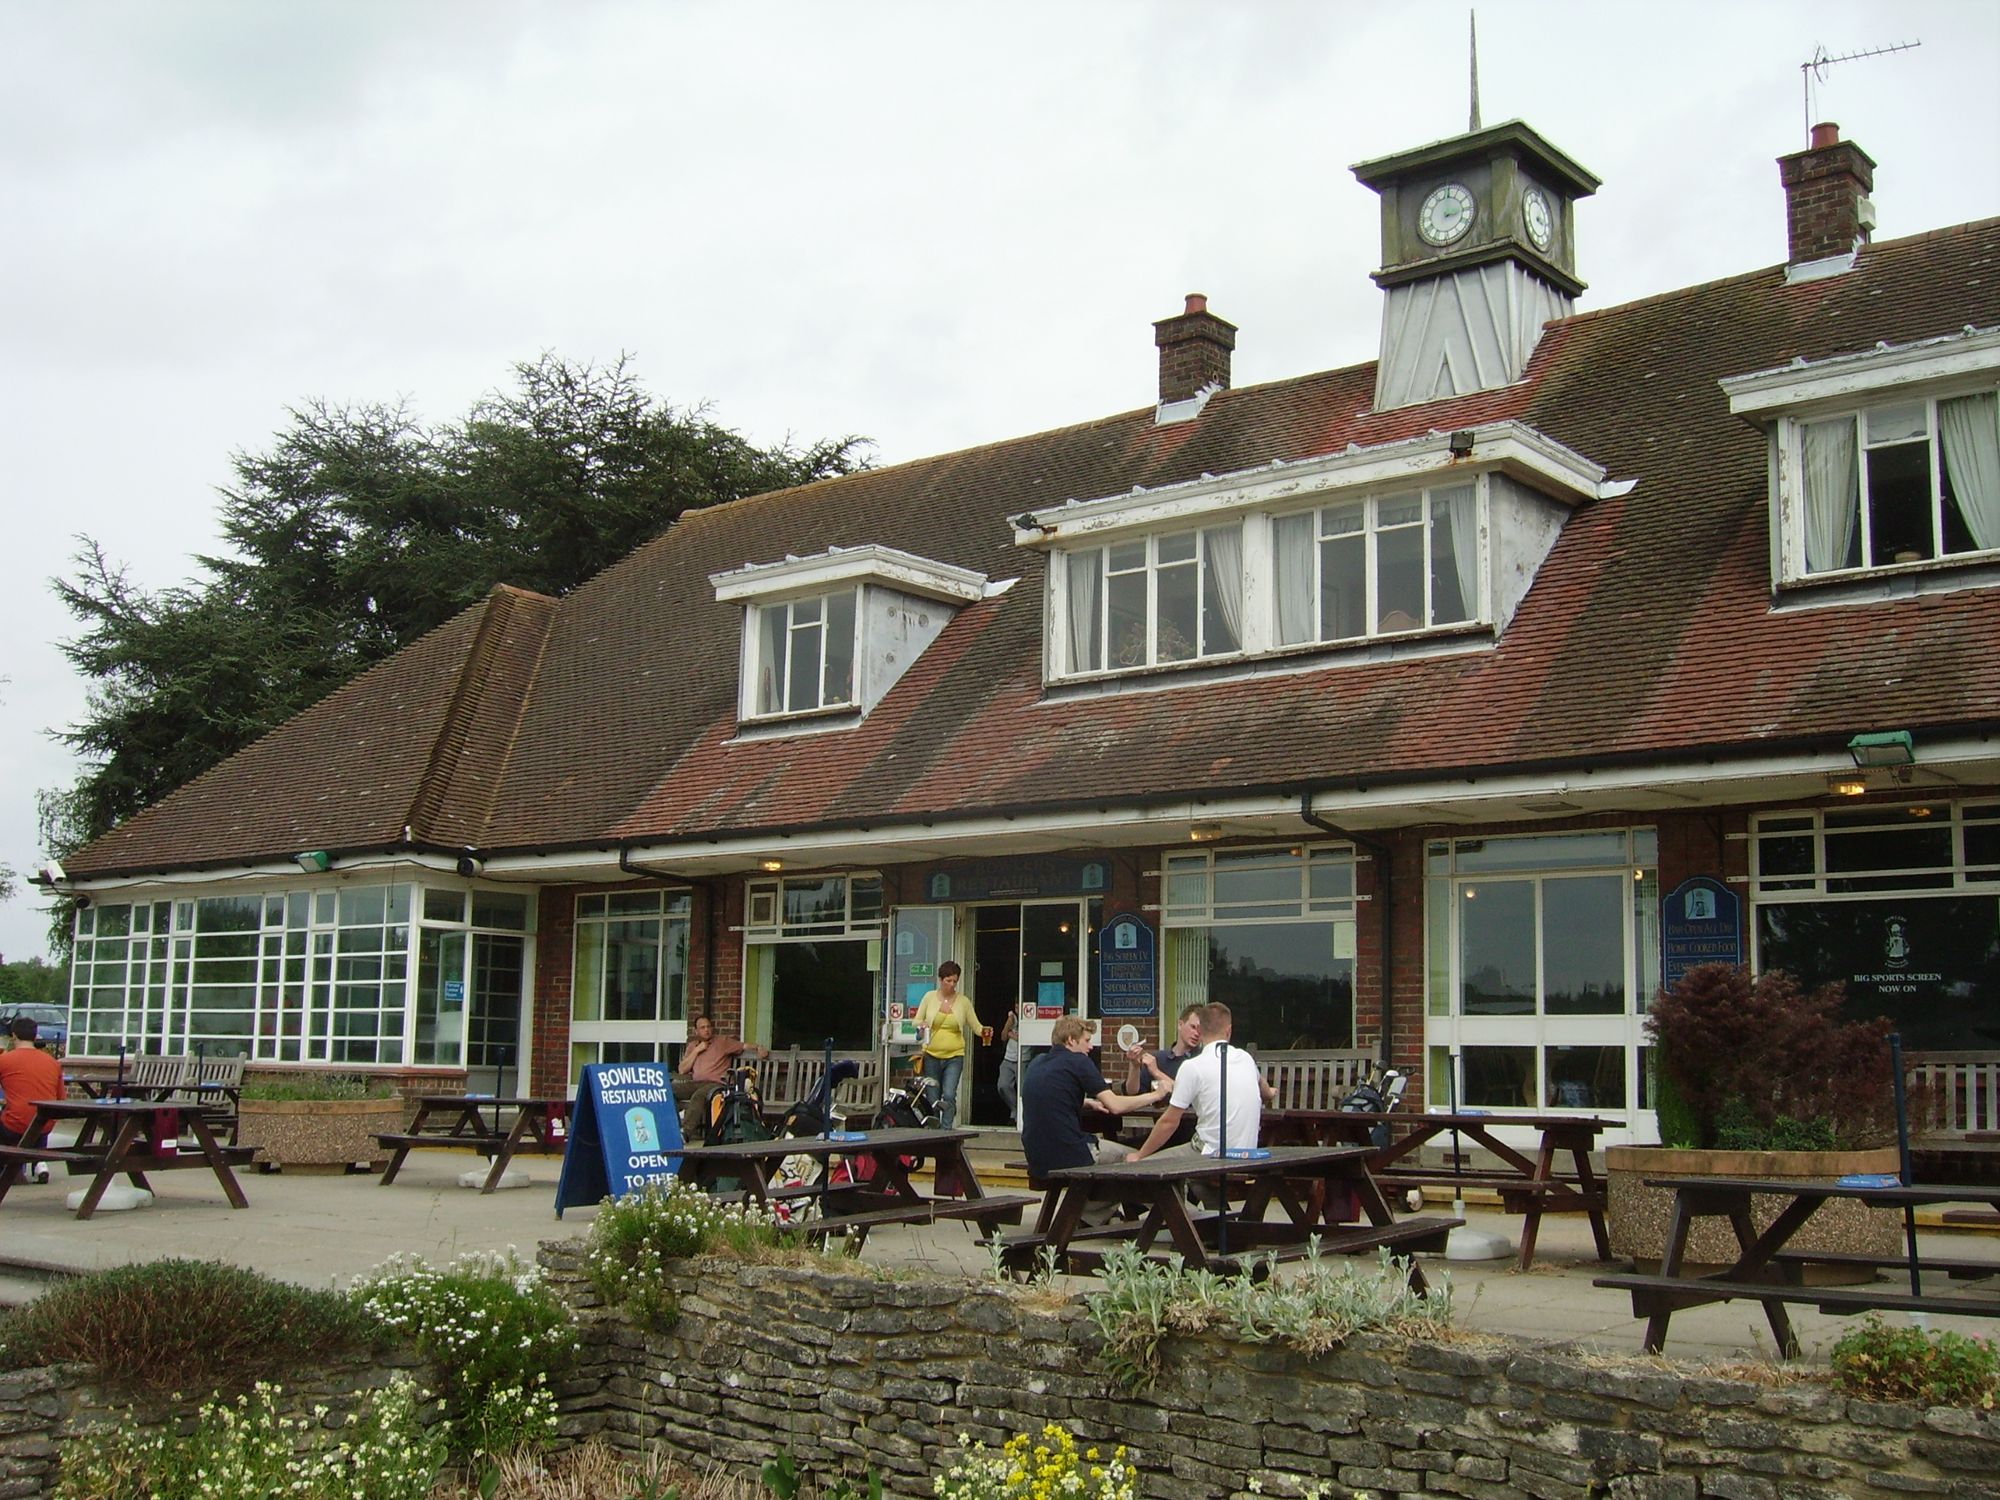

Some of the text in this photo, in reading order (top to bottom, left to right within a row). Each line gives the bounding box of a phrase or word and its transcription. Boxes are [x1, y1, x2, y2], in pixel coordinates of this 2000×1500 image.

[1854, 973, 1941, 982] BIG SPORTS SCREEN
[1879, 985, 1900, 993] NOW
[598, 1066, 664, 1089] BOWLERS
[601, 1088, 667, 1105] RESTAURANT
[628, 1156, 668, 1169] OPEN
[624, 1172, 675, 1188] TO THE
